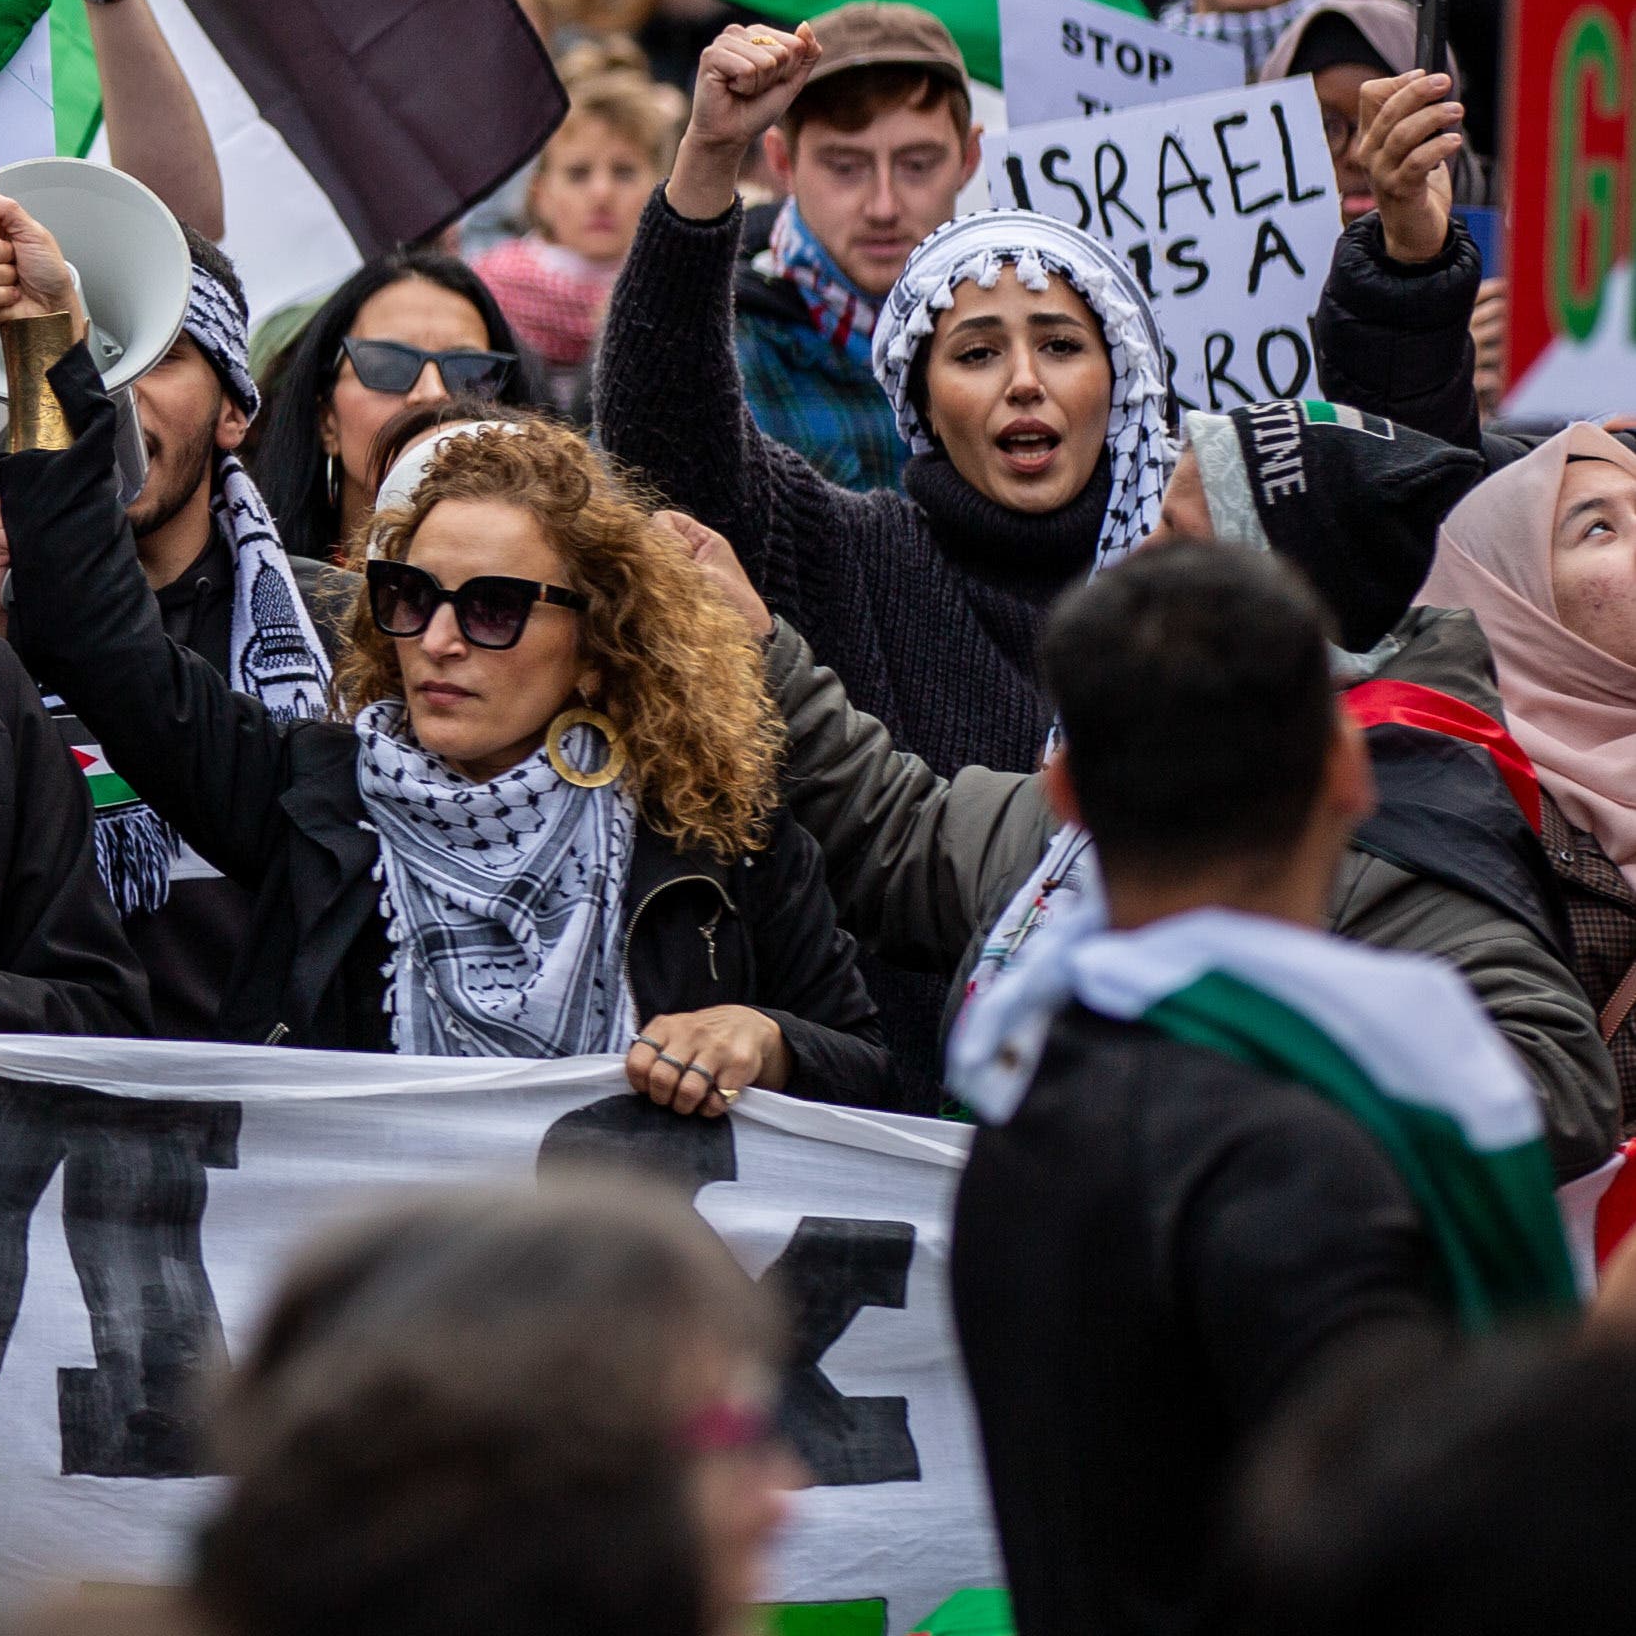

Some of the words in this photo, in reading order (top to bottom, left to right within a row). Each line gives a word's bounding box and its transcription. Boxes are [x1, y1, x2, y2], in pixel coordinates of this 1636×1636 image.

[1061, 18, 1173, 84] STOP
[1004, 100, 1326, 237] ISRAEL
[1128, 238, 1209, 300] IS
[1248, 220, 1305, 294] A
